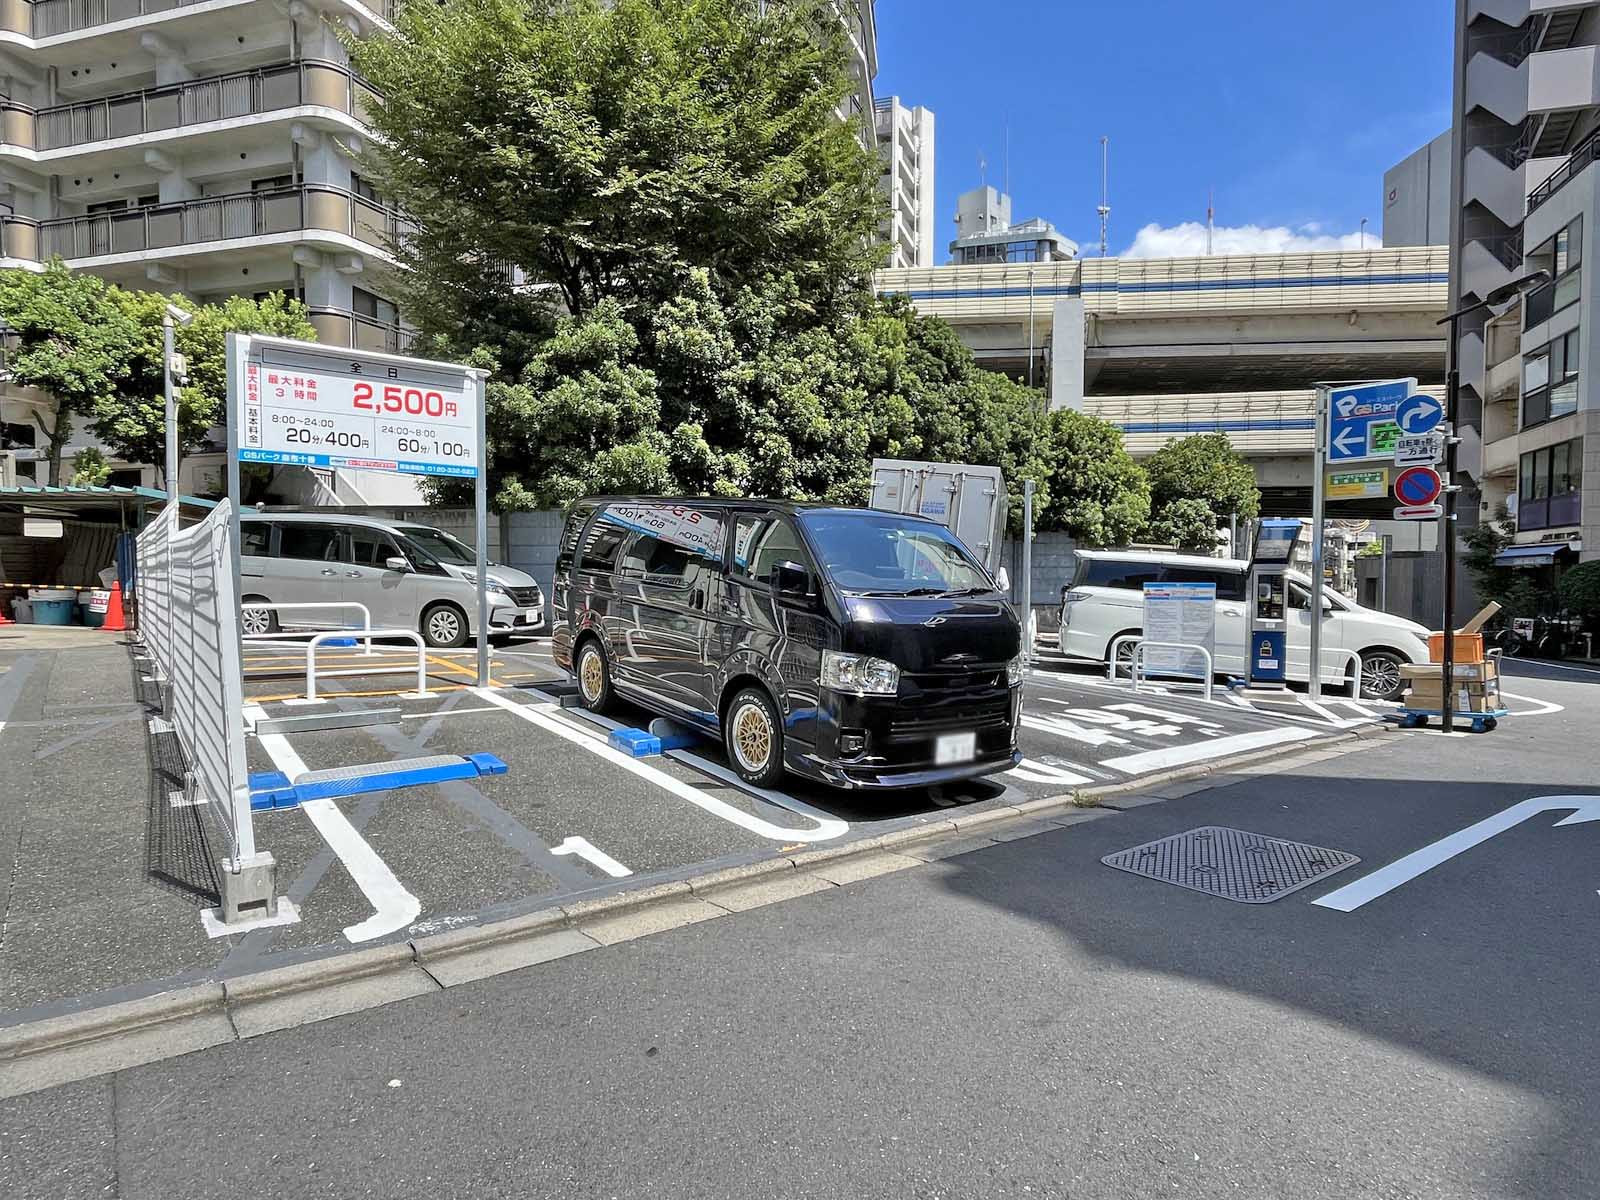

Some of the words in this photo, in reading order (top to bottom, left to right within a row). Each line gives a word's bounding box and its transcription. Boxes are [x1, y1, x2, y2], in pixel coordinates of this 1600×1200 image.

[248, 365, 258, 401] 最大料金
[268, 374, 317, 389] 最大料金
[353, 383, 457, 417] 2,500円
[249, 408, 258, 444] 基本料金
[1397, 447, 1438, 455] 一方通行
